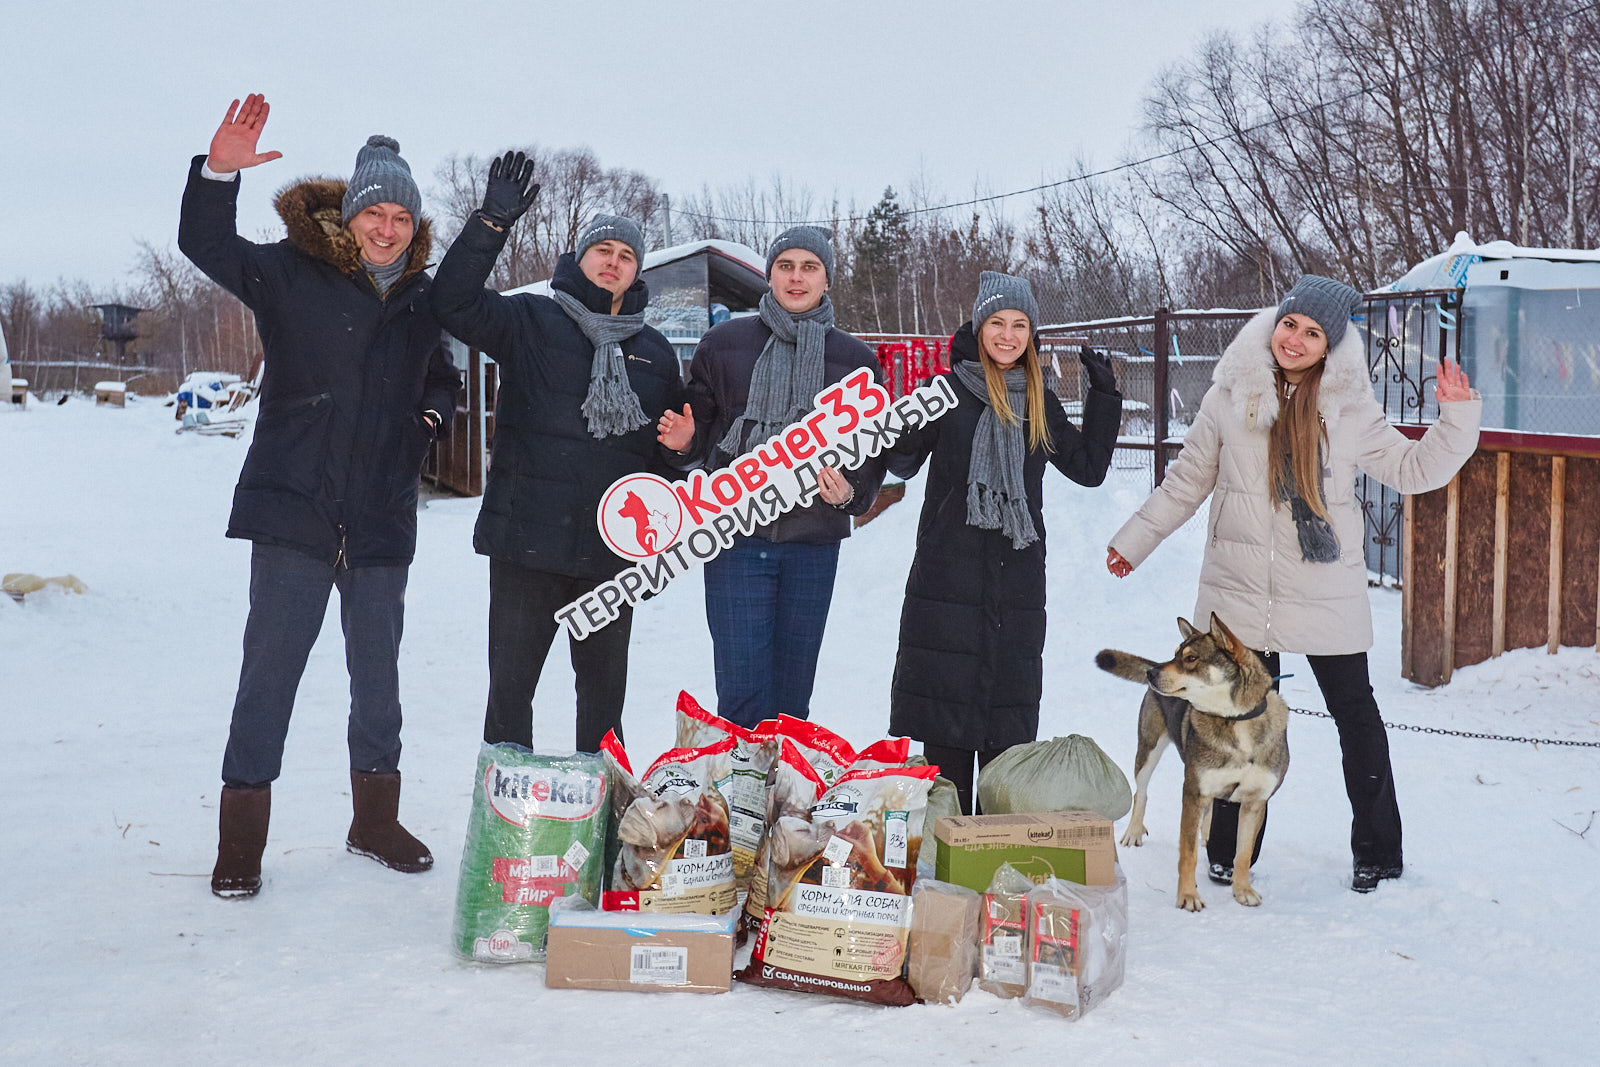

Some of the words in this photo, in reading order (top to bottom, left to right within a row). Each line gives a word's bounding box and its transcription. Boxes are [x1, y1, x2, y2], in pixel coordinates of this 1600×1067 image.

[676, 371, 886, 525] Ковчег33
[558, 483, 788, 638] ТЕРРИТОРИЯ
[793, 376, 956, 506] ДРУЖБЫ
[494, 769, 596, 805] kitekat
[1030, 830, 1051, 839] kitekat
[801, 889, 833, 901] КОРМ
[833, 893, 863, 908] ДЛЯ
[865, 896, 902, 910] СОБАК
[797, 903, 830, 915] СРЕДНИХ
[876, 912, 900, 922] ПОРОД
[834, 962, 863, 971] МЯГКАЯ
[775, 970, 872, 993] СБАЛАНСИРОВАННО
